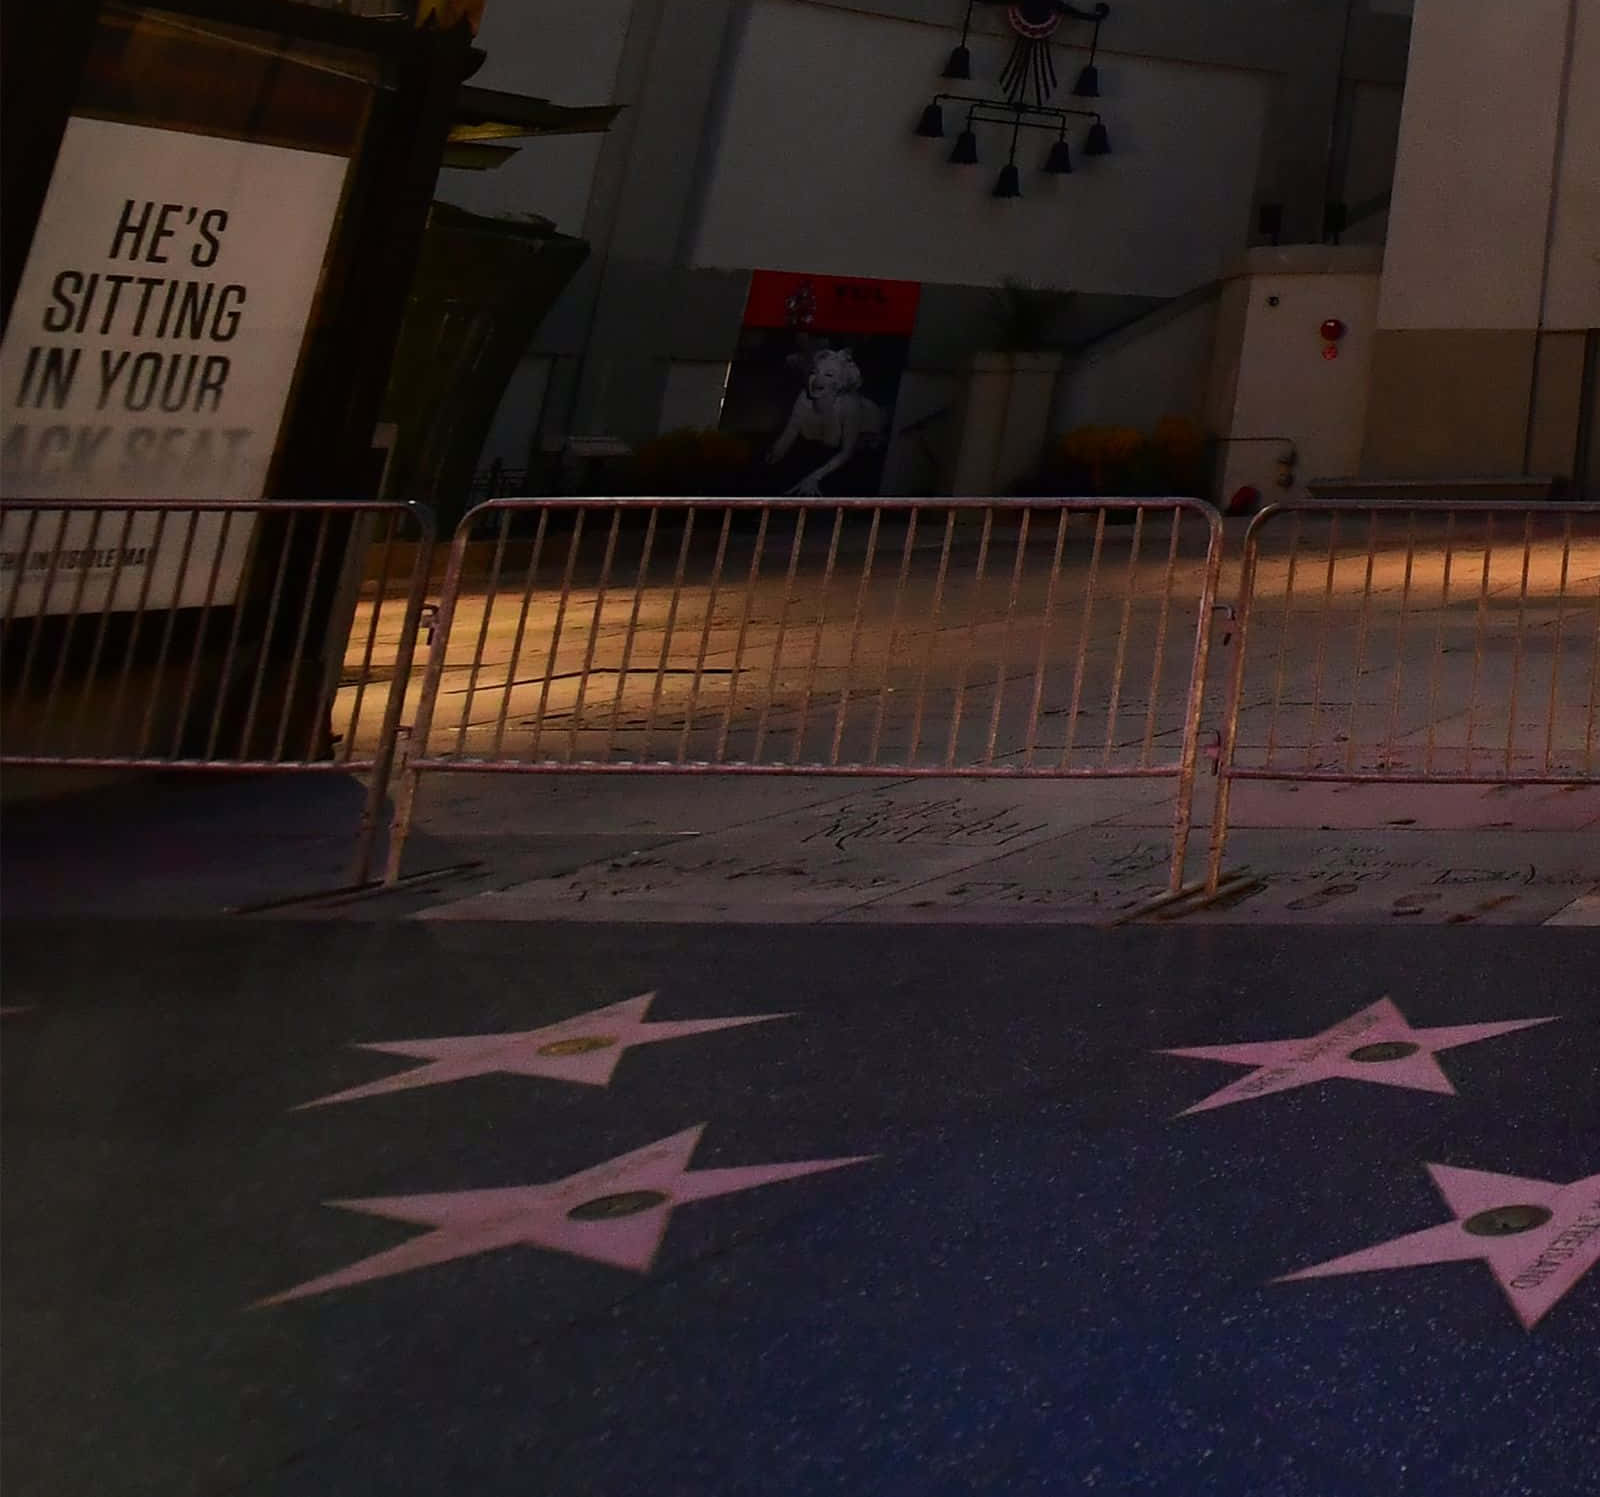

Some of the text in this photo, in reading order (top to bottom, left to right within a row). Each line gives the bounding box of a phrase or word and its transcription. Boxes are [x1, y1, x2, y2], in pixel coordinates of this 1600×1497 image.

[108, 200, 228, 267] HE'S
[43, 271, 246, 341] SITTING
[16, 346, 231, 413] IN YOUR
